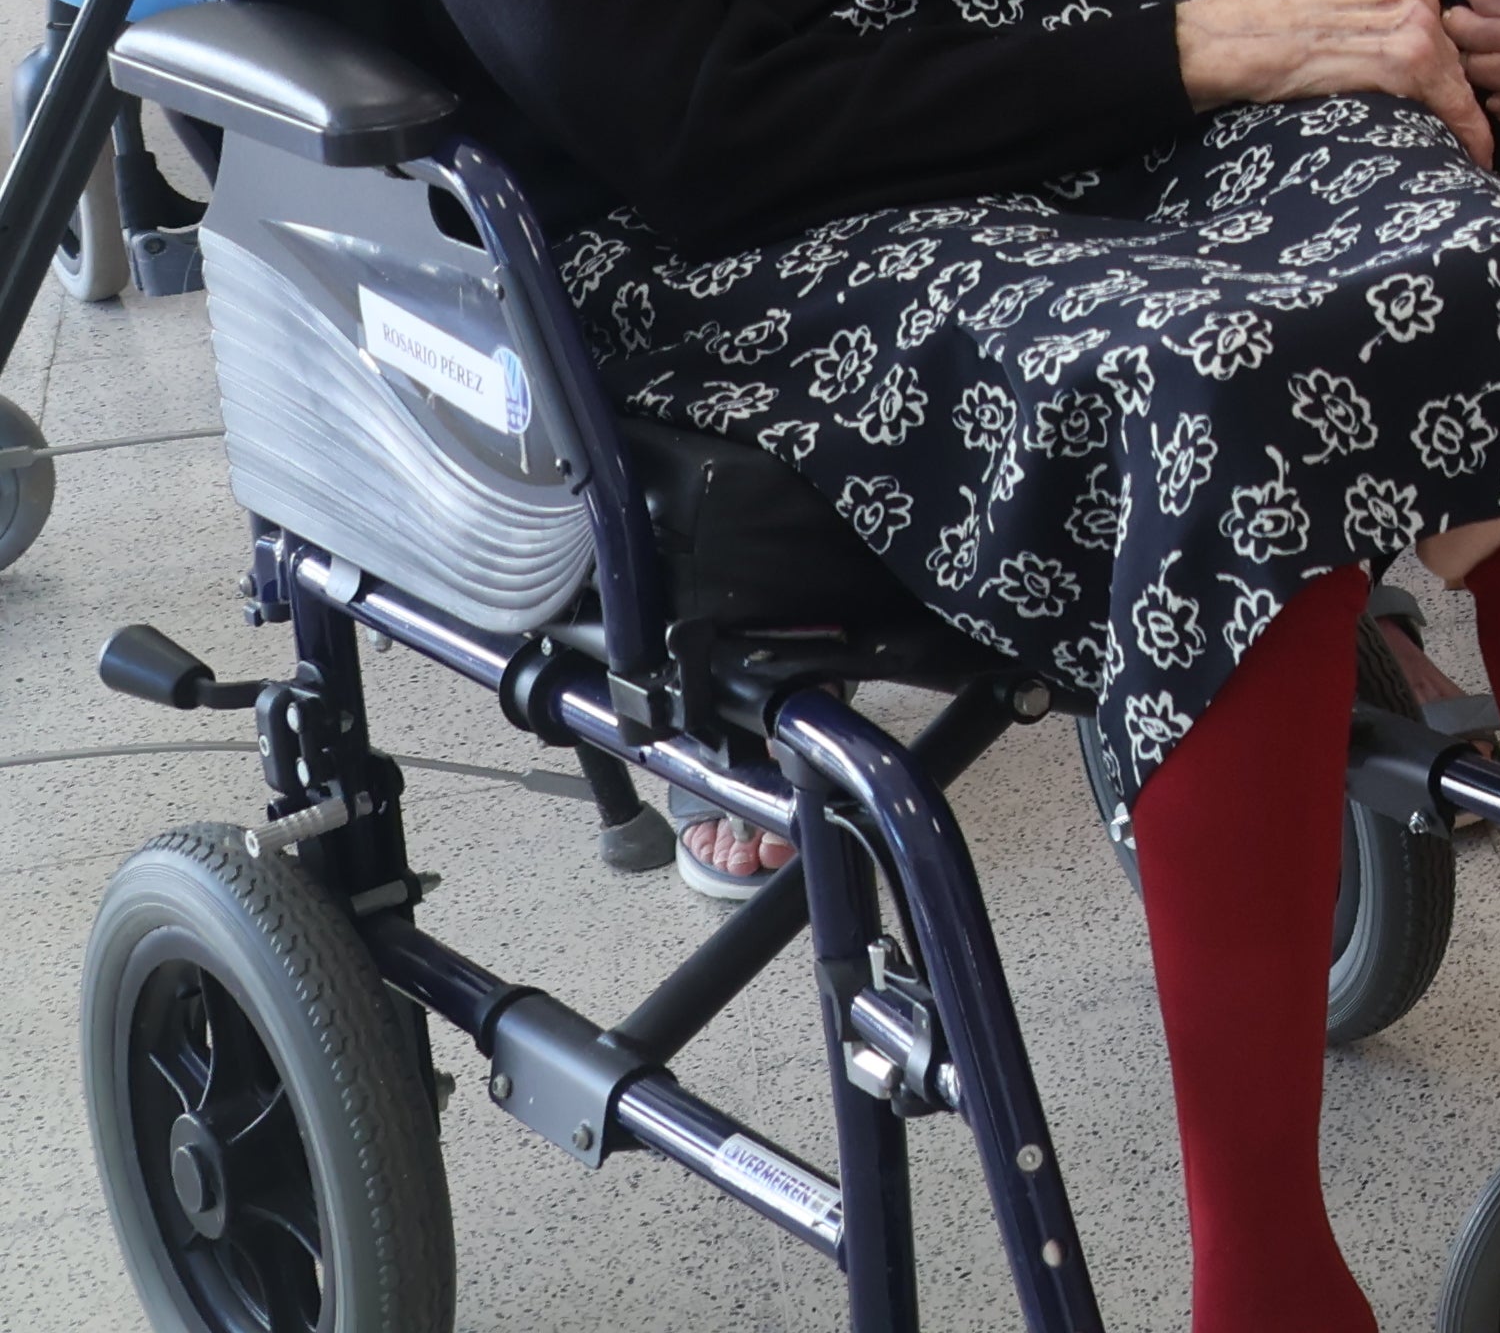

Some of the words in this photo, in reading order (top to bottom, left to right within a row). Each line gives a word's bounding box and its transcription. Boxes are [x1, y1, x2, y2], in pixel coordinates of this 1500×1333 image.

[381, 321, 438, 370] ROSARIO
[440, 355, 485, 395] PÉREZ
[738, 1148, 818, 1206] VERMEIREN
